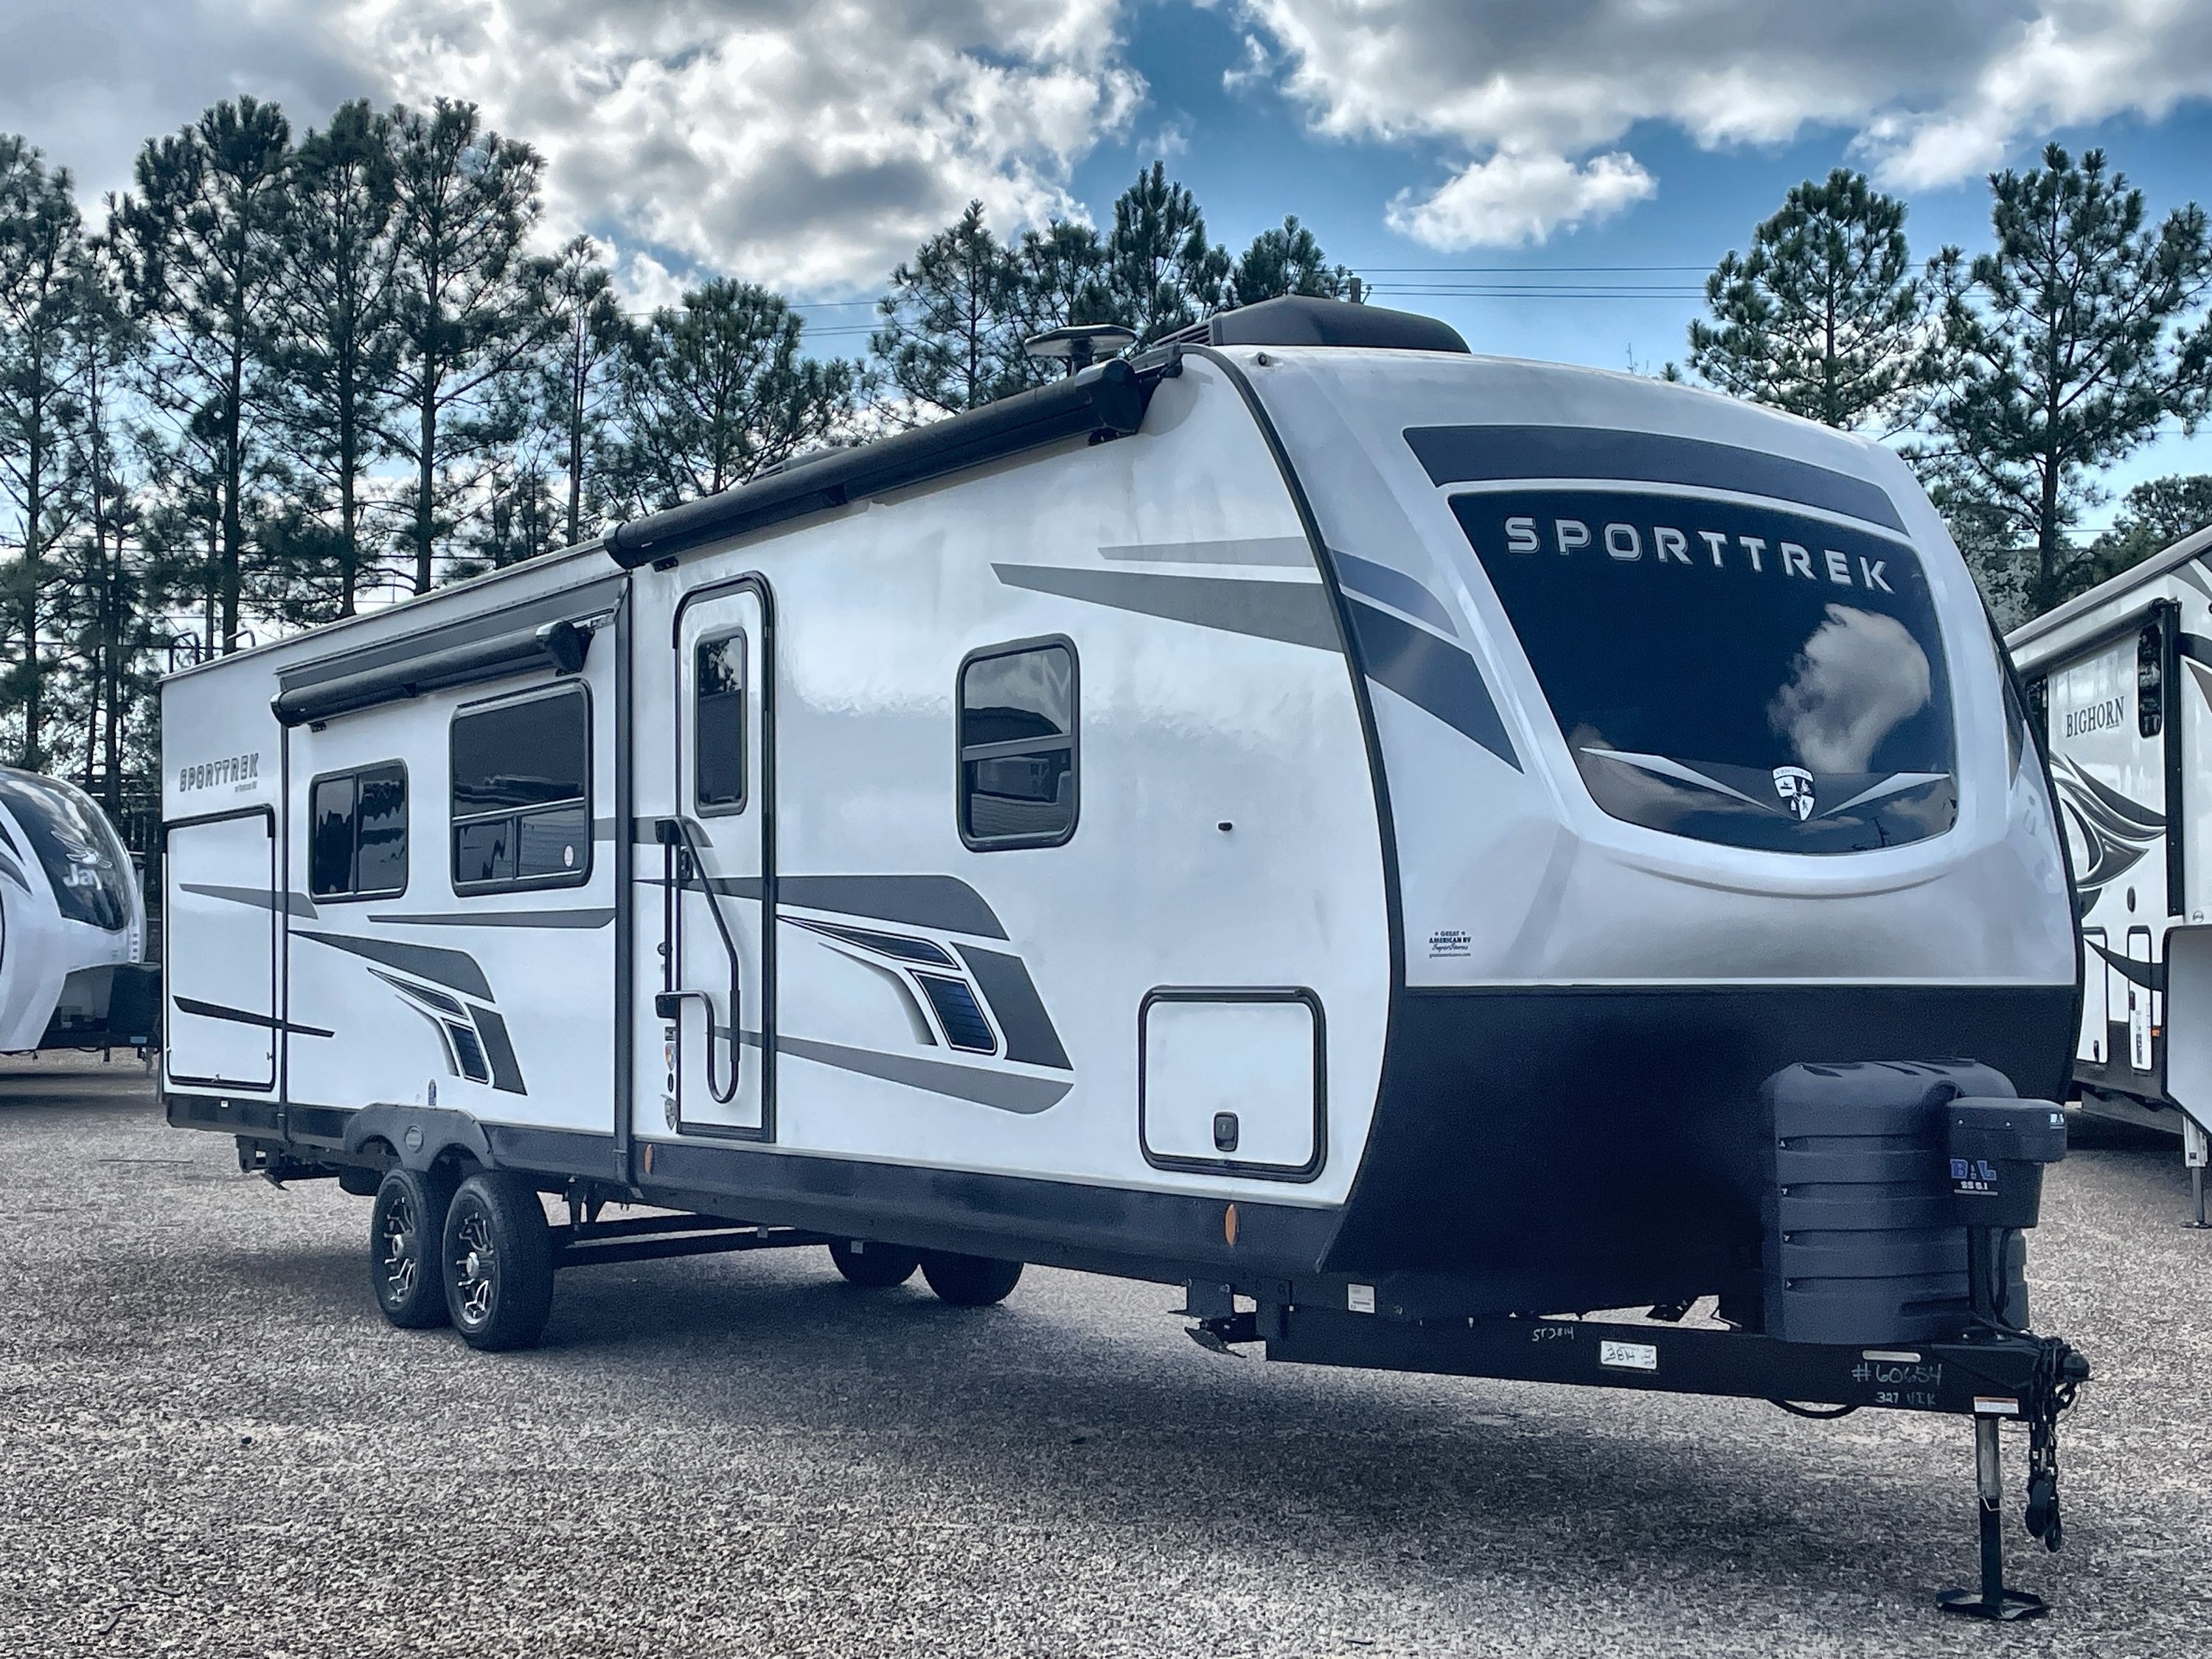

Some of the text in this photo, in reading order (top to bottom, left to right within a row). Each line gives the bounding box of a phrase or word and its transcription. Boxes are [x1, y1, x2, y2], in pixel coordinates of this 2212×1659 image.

[1504, 516, 1896, 594] SPORTTREK
[2065, 695, 2124, 738] BIGHORN
[179, 752, 260, 793] SPORTTREK
